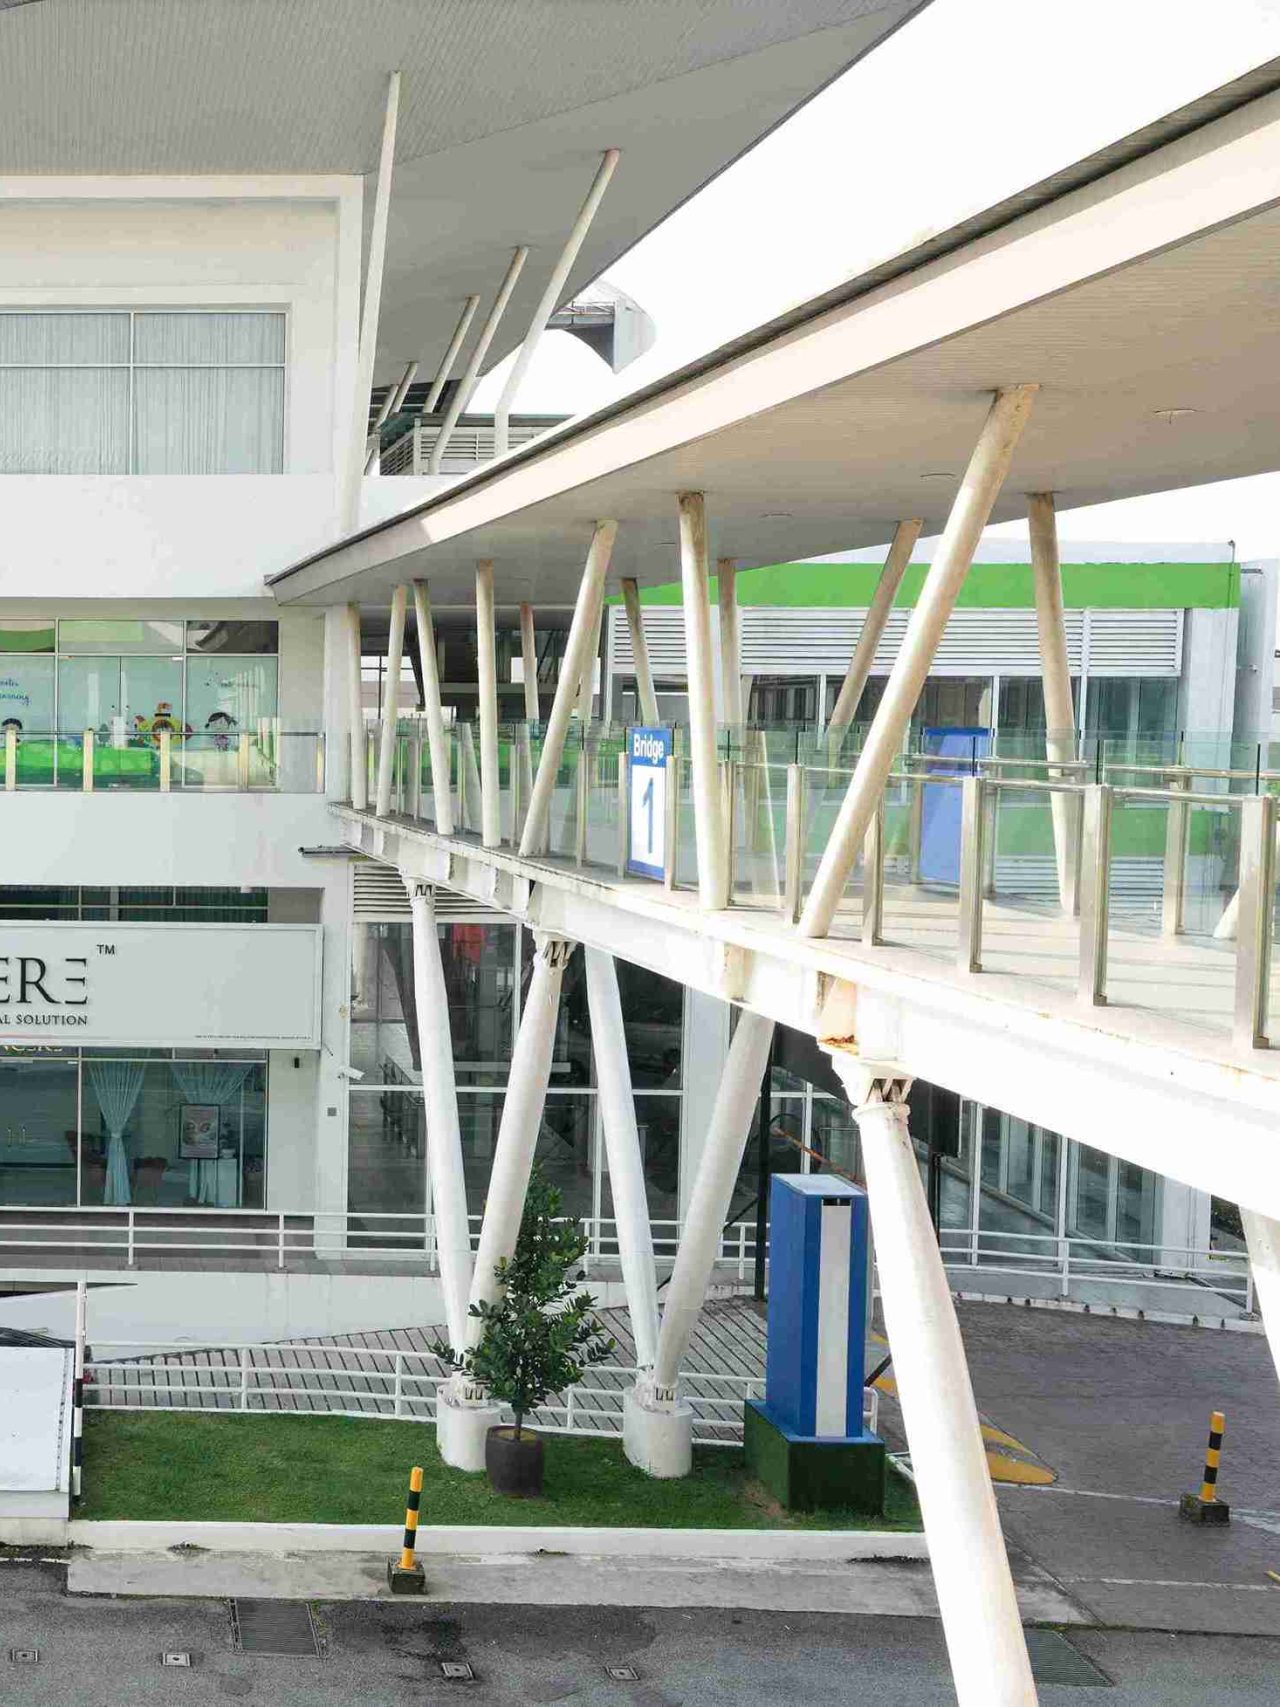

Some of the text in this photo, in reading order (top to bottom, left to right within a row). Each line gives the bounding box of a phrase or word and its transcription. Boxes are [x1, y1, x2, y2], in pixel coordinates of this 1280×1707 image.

[633, 733, 664, 764] Bridge
[642, 777, 654, 854] 1
[16, 1014, 88, 1026] SOLUTION
